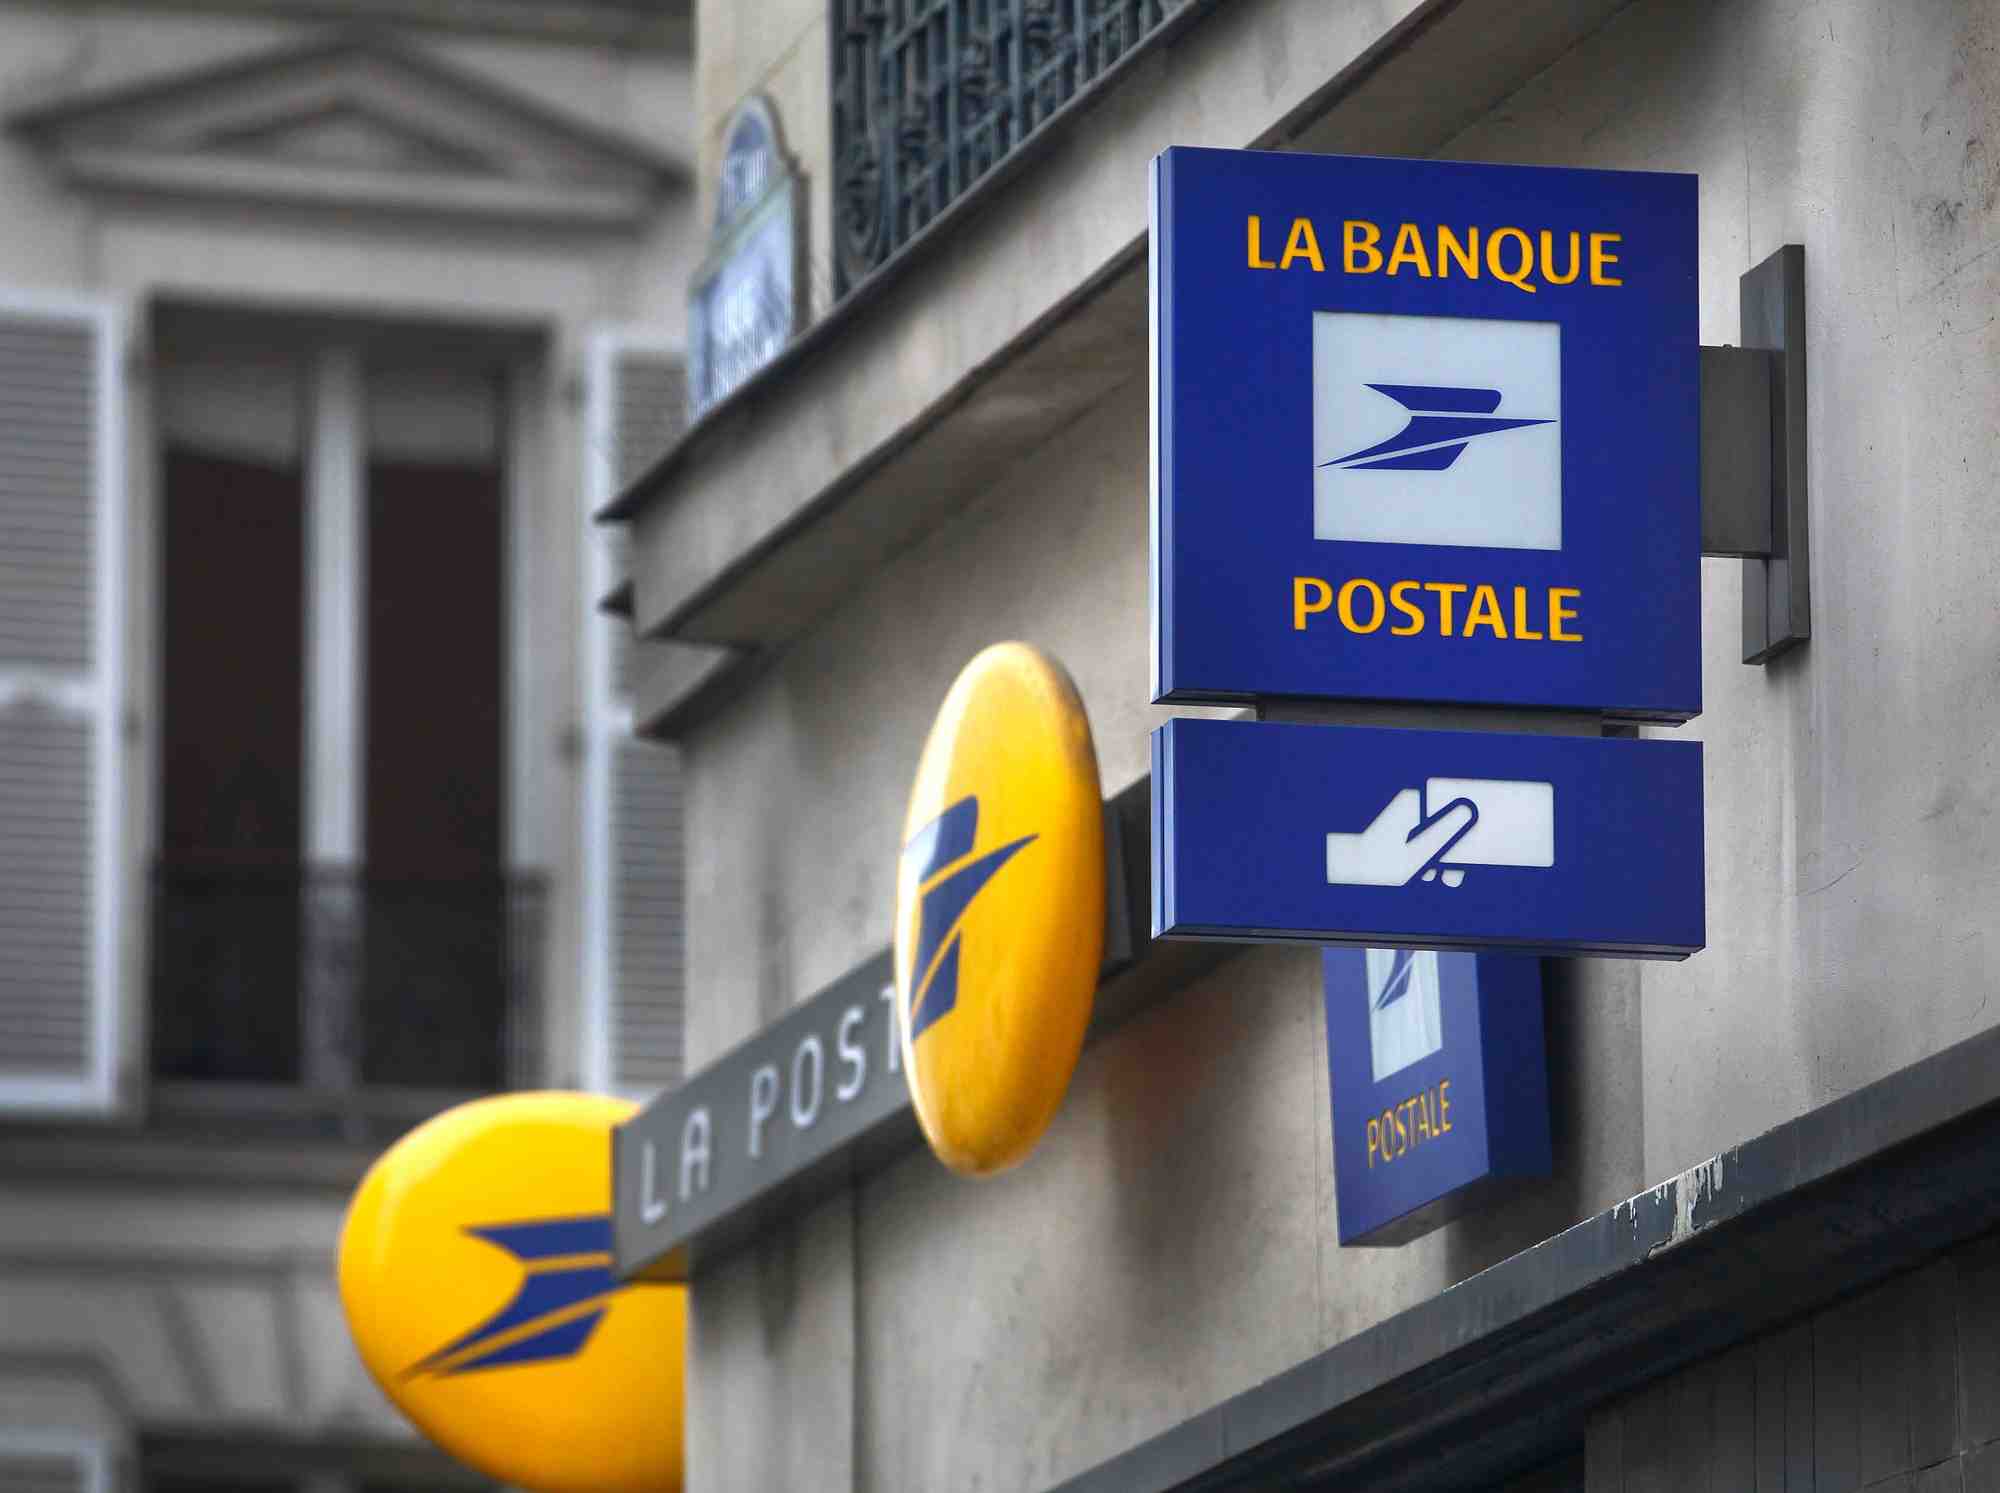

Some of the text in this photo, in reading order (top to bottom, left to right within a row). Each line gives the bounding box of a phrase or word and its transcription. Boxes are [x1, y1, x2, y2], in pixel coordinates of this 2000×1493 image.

[1246, 214, 1623, 293] LA BANQUE
[1293, 576, 1583, 643] POSTALE
[641, 1106, 710, 1223] LA
[1366, 1077, 1453, 1169] POSTALE
